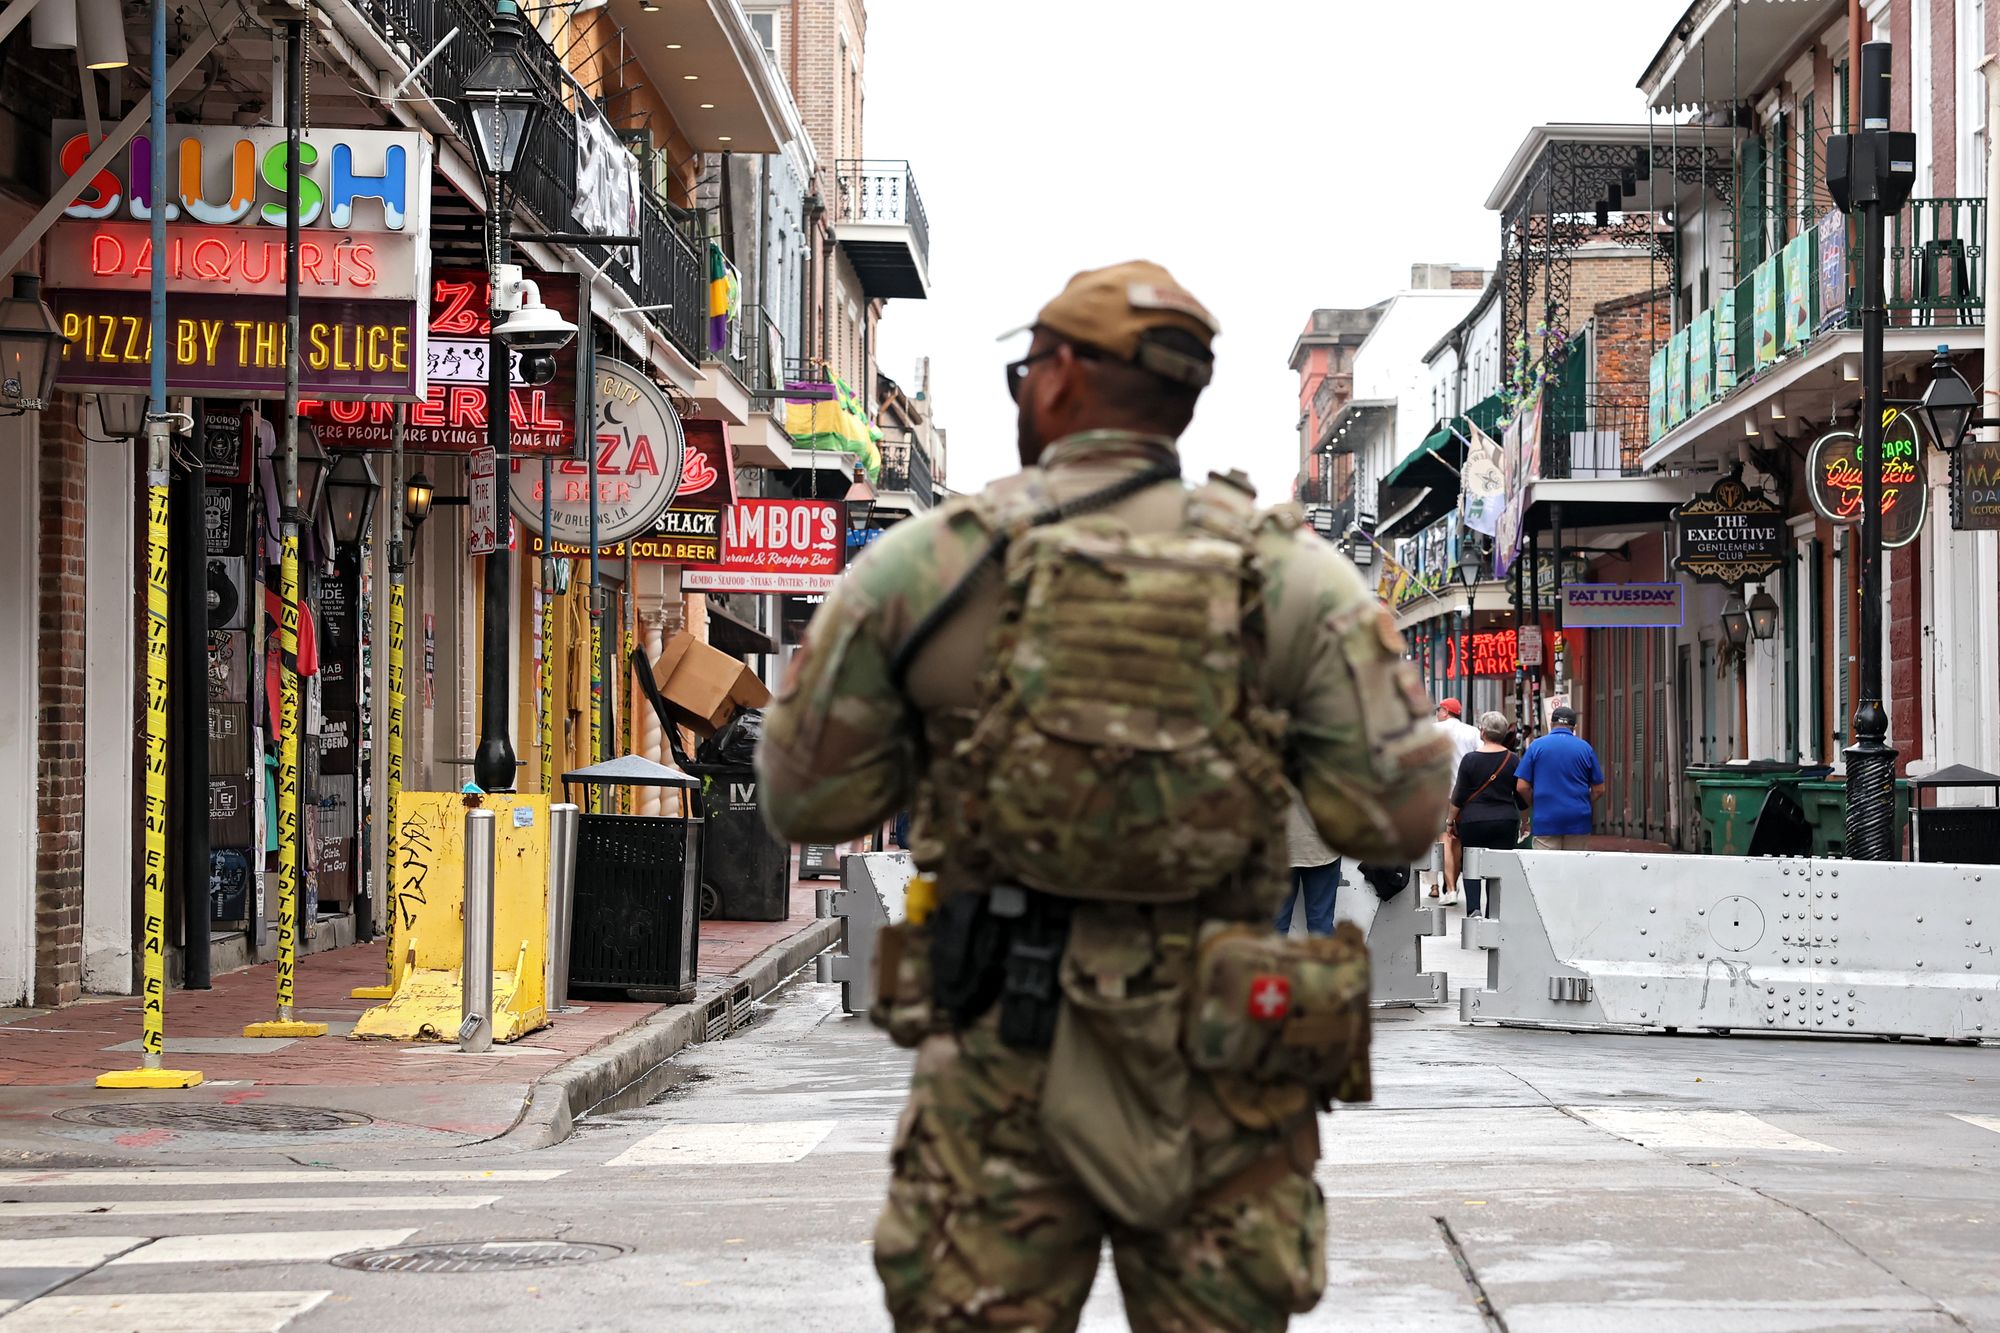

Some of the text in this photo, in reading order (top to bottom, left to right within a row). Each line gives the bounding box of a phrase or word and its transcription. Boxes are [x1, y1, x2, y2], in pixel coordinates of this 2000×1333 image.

[59, 132, 407, 230] SLUSH
[92, 234, 378, 287] DAIQUIRIS
[61, 313, 151, 363] PIZZ
[177, 319, 224, 367] BY
[309, 322, 409, 373] SLICE
[604, 377, 642, 406] CITY
[348, 427, 393, 440] PEOPL
[432, 429, 477, 444] DYING
[509, 433, 540, 446] OME
[476, 483, 489, 500] FIRE
[475, 505, 490, 523] LANE
[565, 512, 614, 526] ORLENS,
[615, 507, 629, 519] LA
[1715, 515, 1748, 528] THE
[655, 512, 716, 534] SHACK
[726, 505, 837, 550] AMBO'S
[1688, 528, 1776, 541] EXECUTIVE
[632, 542, 672, 558] COLD
[677, 545, 716, 560] BEER
[1698, 543, 1765, 552] GENTLEMEN'S
[1718, 552, 1744, 560] CLUB
[755, 552, 765, 564] &
[768, 553, 809, 568] Rooftop
[811, 553, 833, 565] Bar
[1569, 589, 1675, 602] FAT TUESDAY
[225, 720, 232, 729] B
[325, 721, 347, 733] MAN
[319, 736, 348, 748] LEGEND
[220, 793, 233, 804] Er
[730, 783, 756, 803] IV
[333, 861, 347, 872] Gay
